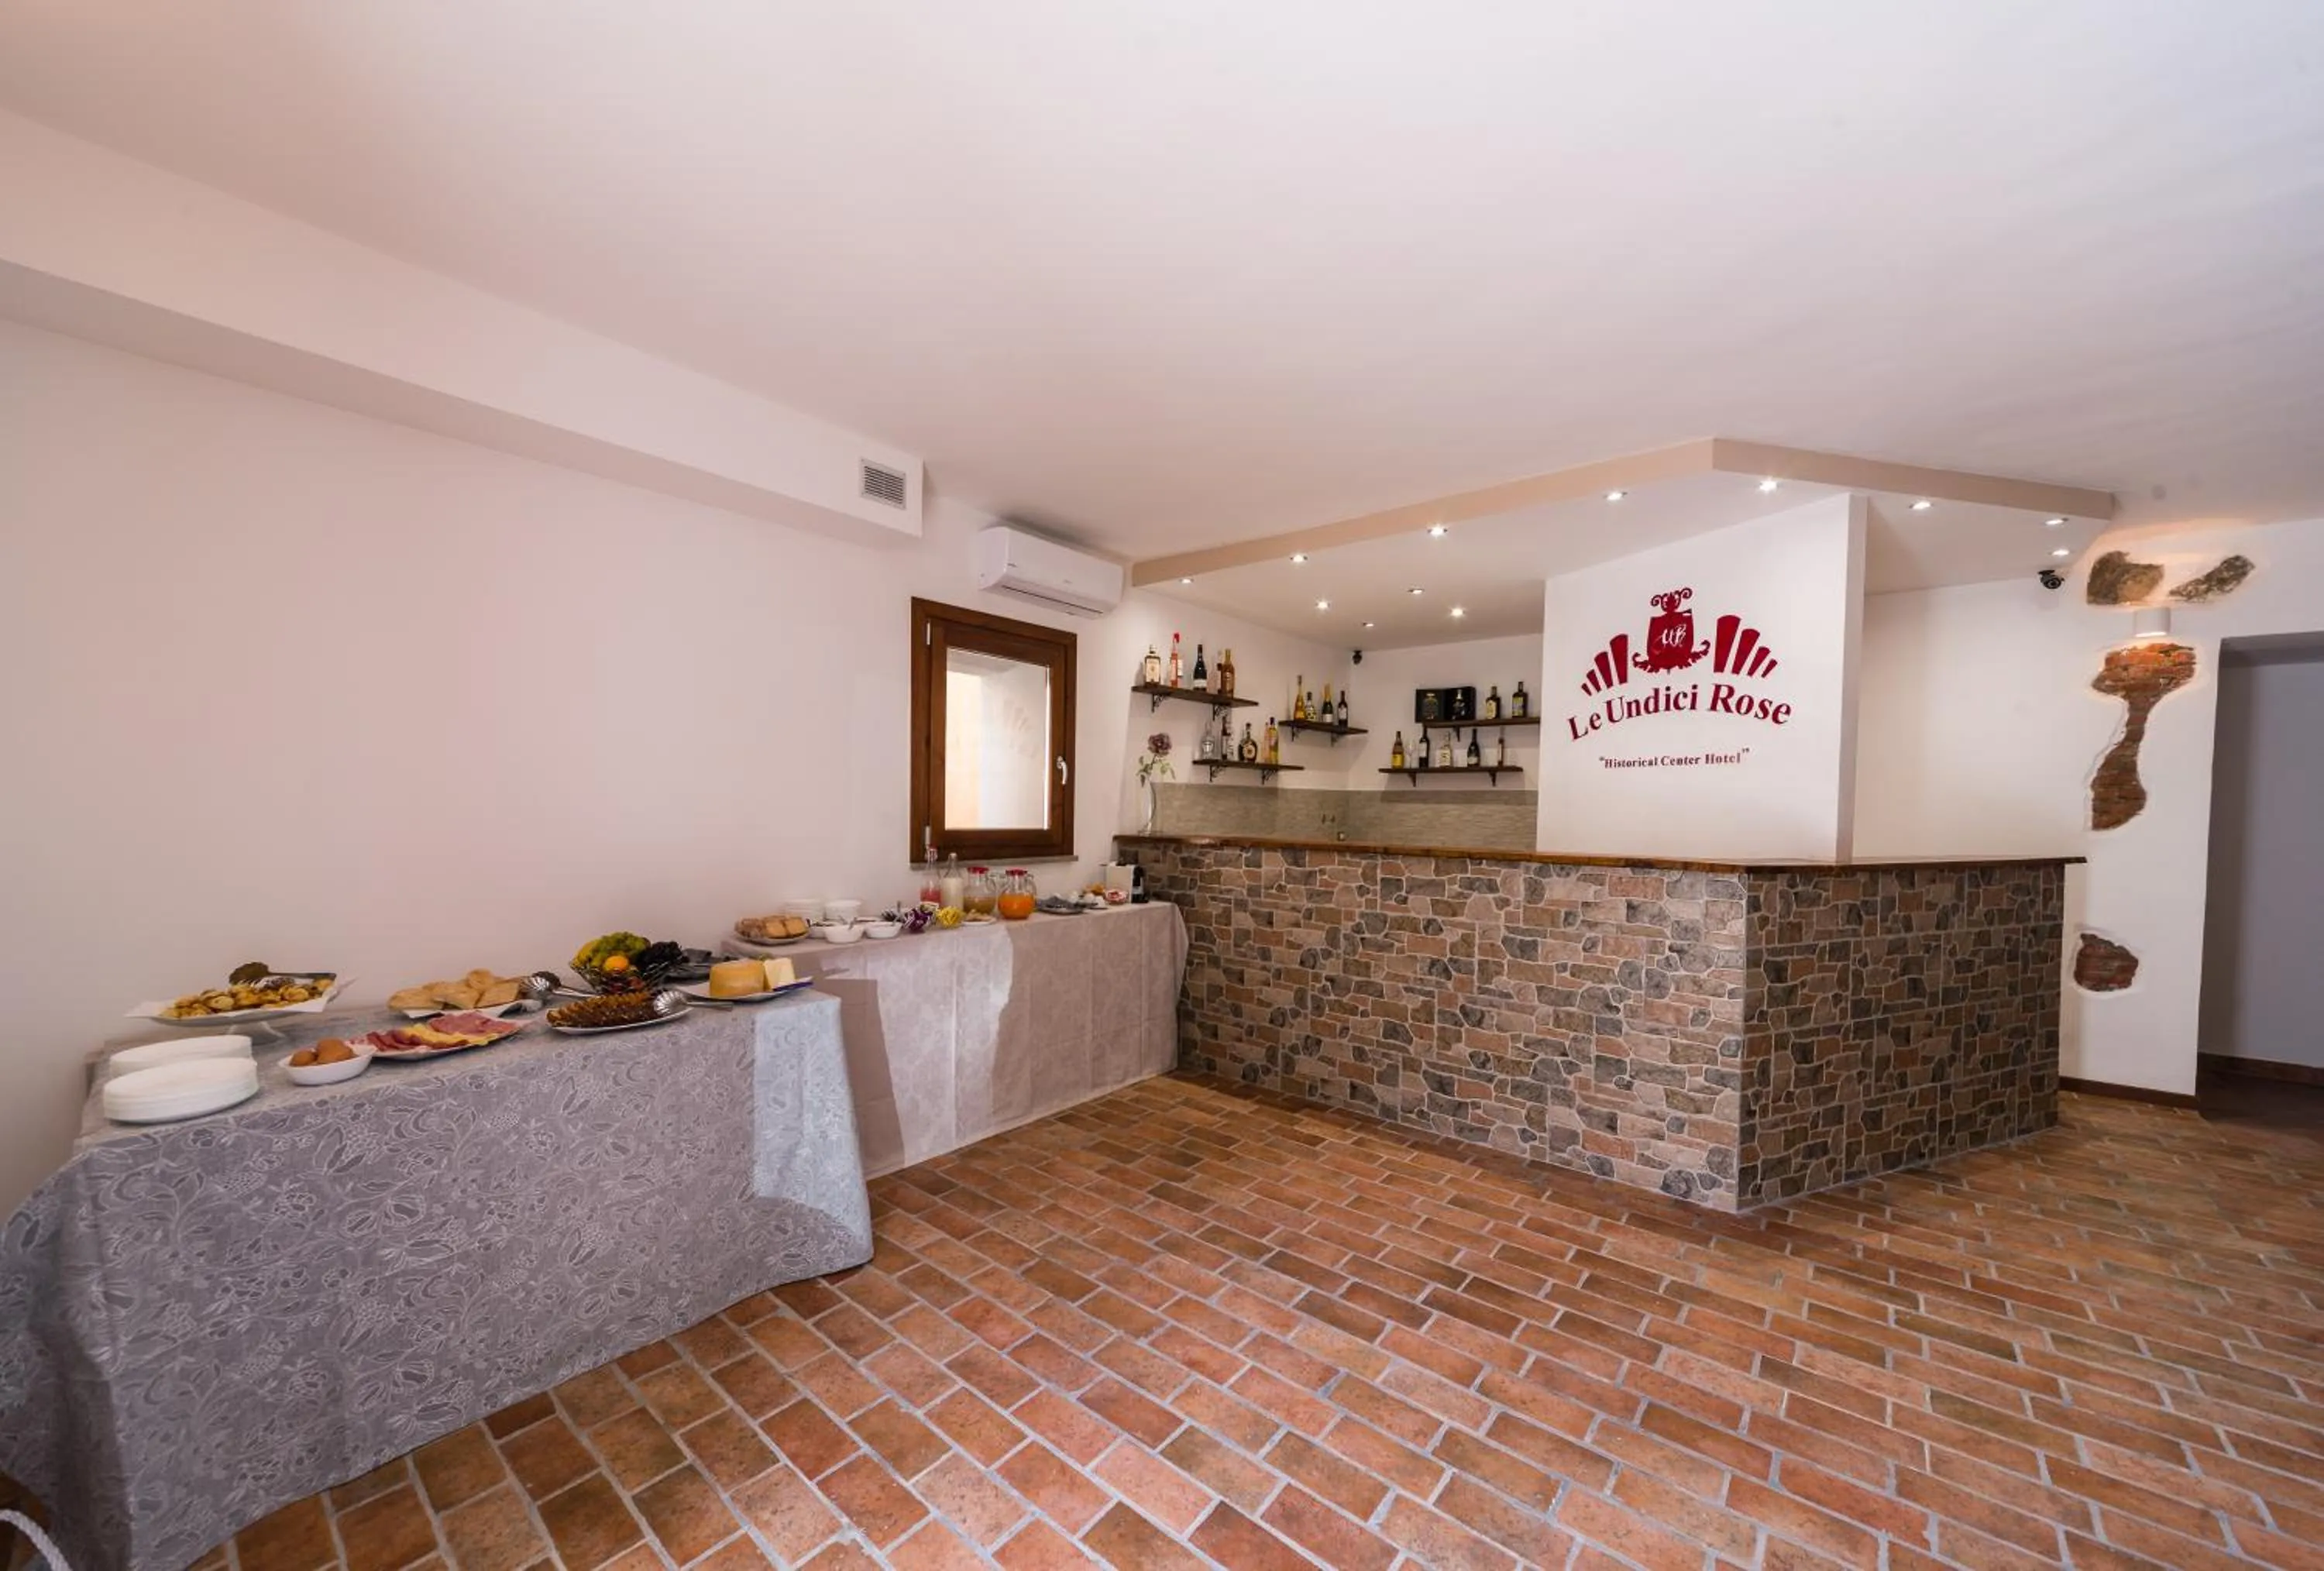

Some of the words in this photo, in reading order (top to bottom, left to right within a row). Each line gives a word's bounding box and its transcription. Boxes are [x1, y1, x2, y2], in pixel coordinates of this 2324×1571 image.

[1568, 712, 1602, 741] Le
[1604, 685, 1698, 724] Undici
[1708, 683, 1792, 724] Rose
[1660, 755, 1701, 767] Center
